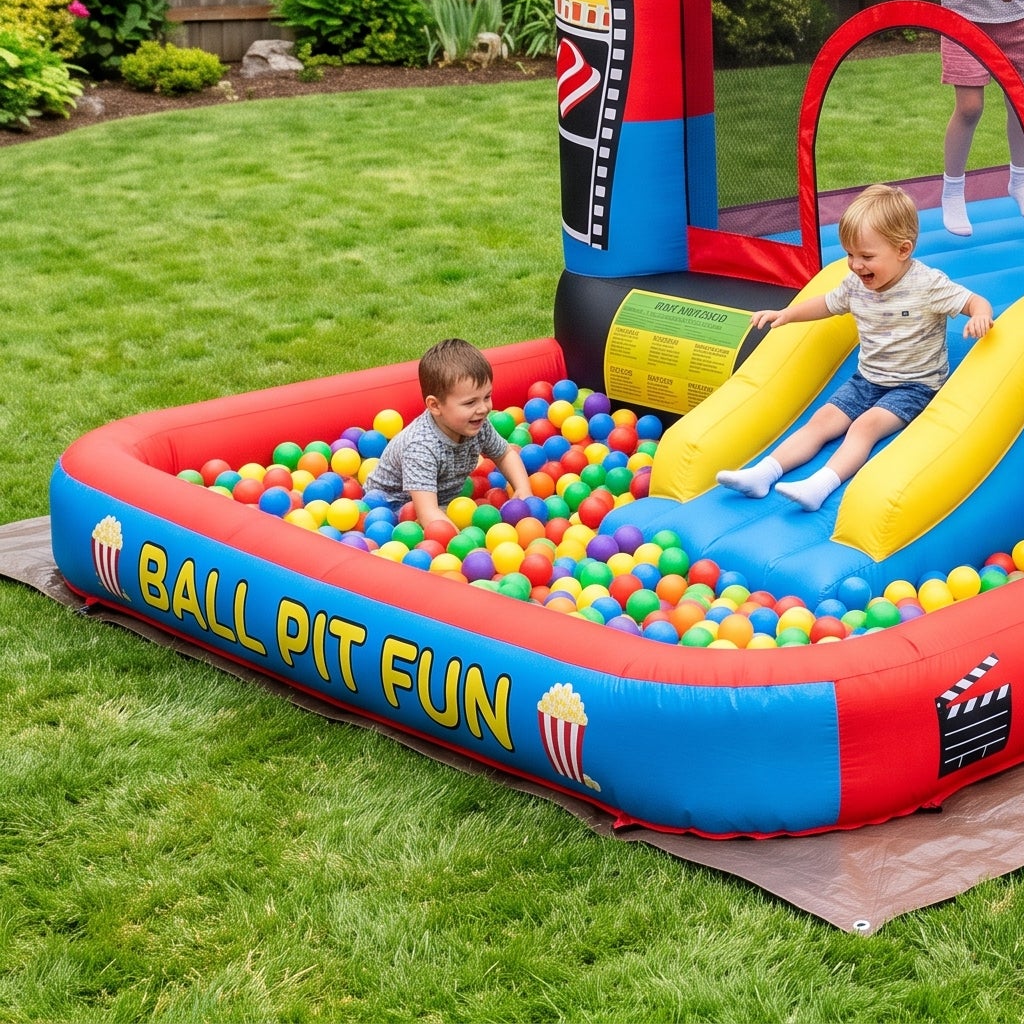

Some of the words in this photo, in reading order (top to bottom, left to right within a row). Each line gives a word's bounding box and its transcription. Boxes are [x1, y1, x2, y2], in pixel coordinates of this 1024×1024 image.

[138, 541, 267, 657] BALL
[276, 596, 367, 693] PIT
[380, 634, 515, 752] FUN
